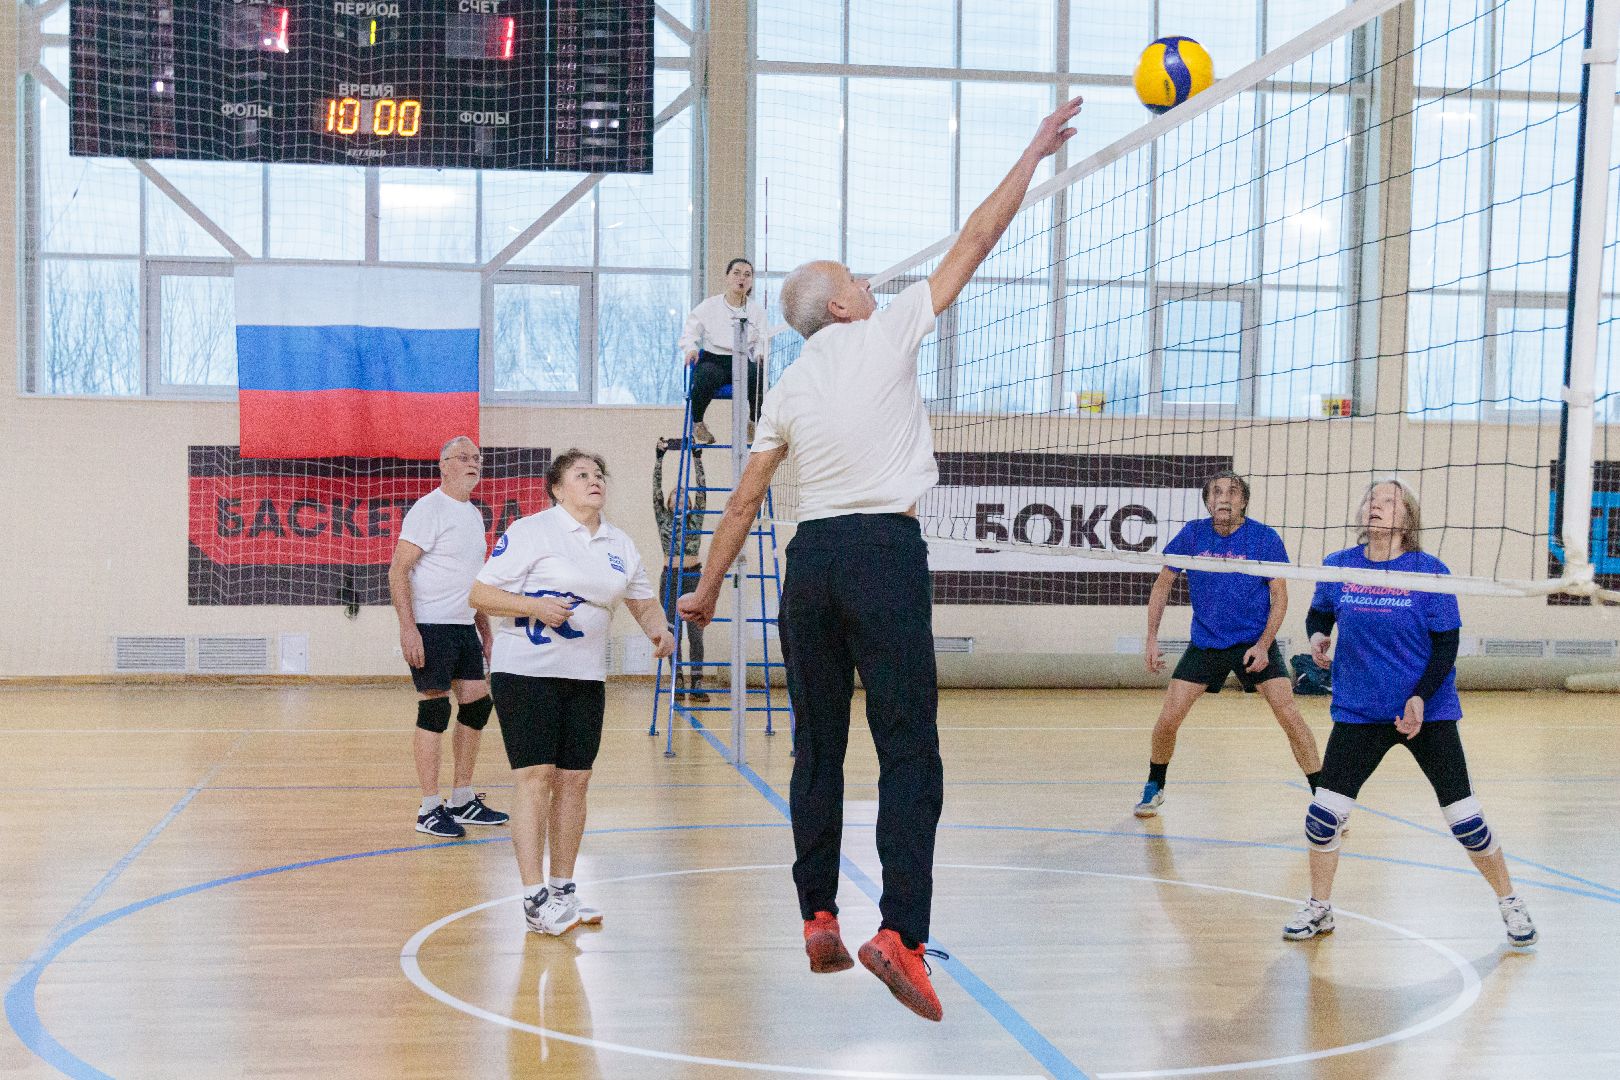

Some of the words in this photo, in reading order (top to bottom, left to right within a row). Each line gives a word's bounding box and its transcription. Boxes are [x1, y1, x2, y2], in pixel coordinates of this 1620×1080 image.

[334, 1, 400, 18] ПЕРИОД
[459, 0, 500, 13] СЧЕТ
[370, 19, 377, 46] 1
[504, 17, 515, 57] 1
[338, 83, 394, 97] ВРЕМЯ
[221, 103, 274, 119] ФОЛЫ
[326, 97, 361, 135] 10
[373, 99, 421, 136] 00
[459, 110, 511, 126] ФОЛЫ
[216, 498, 523, 539] БАСКЕЛ
[975, 502, 1158, 554] БОКС
[1340, 592, 1412, 607] долголетие
